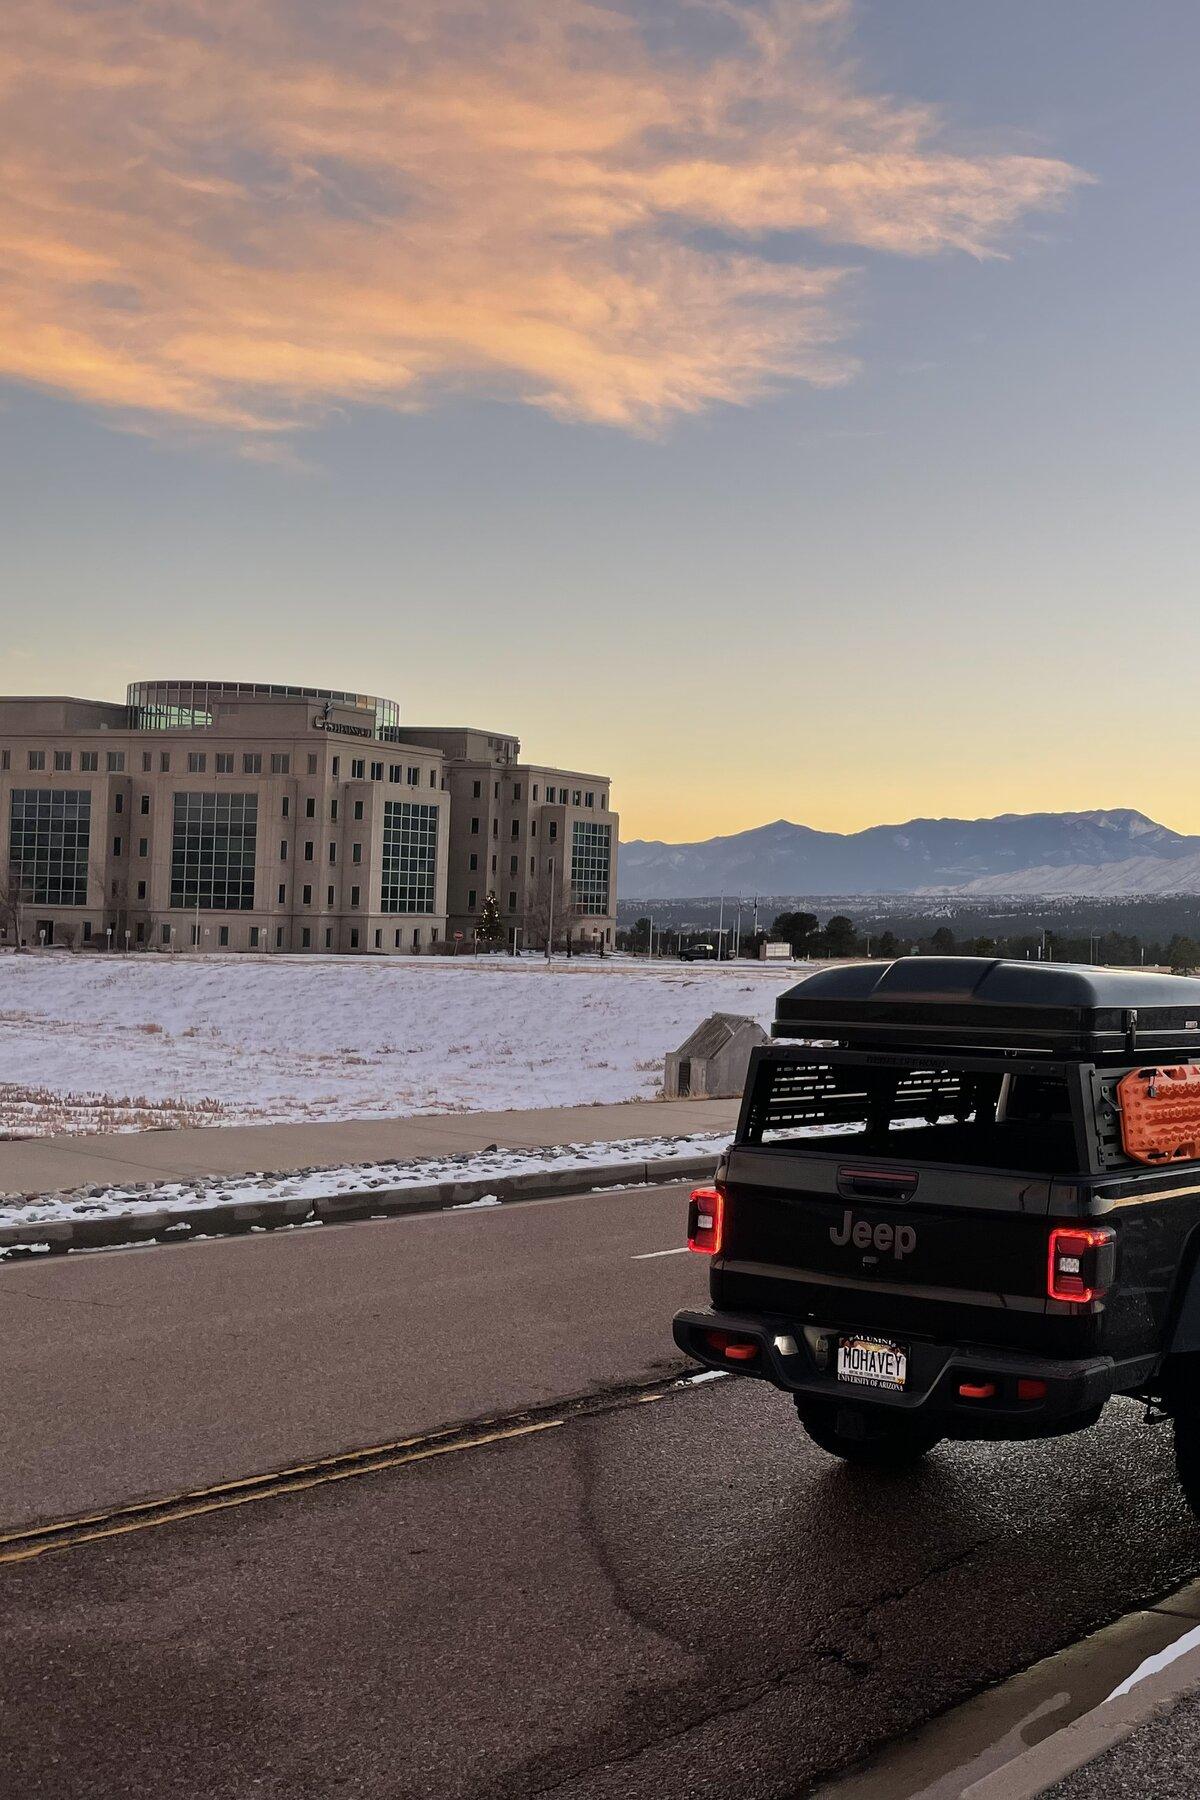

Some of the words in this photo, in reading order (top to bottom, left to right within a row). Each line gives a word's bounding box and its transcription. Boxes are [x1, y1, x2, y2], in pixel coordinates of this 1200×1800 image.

[829, 1210, 917, 1260] Jeep
[853, 1334, 893, 1346] ALUMNI
[843, 1346, 904, 1376] MOHAVEY
[837, 1373, 869, 1387] UNIVERSITY
[870, 1379, 879, 1388] OF
[879, 1381, 904, 1392] ARIZONA
